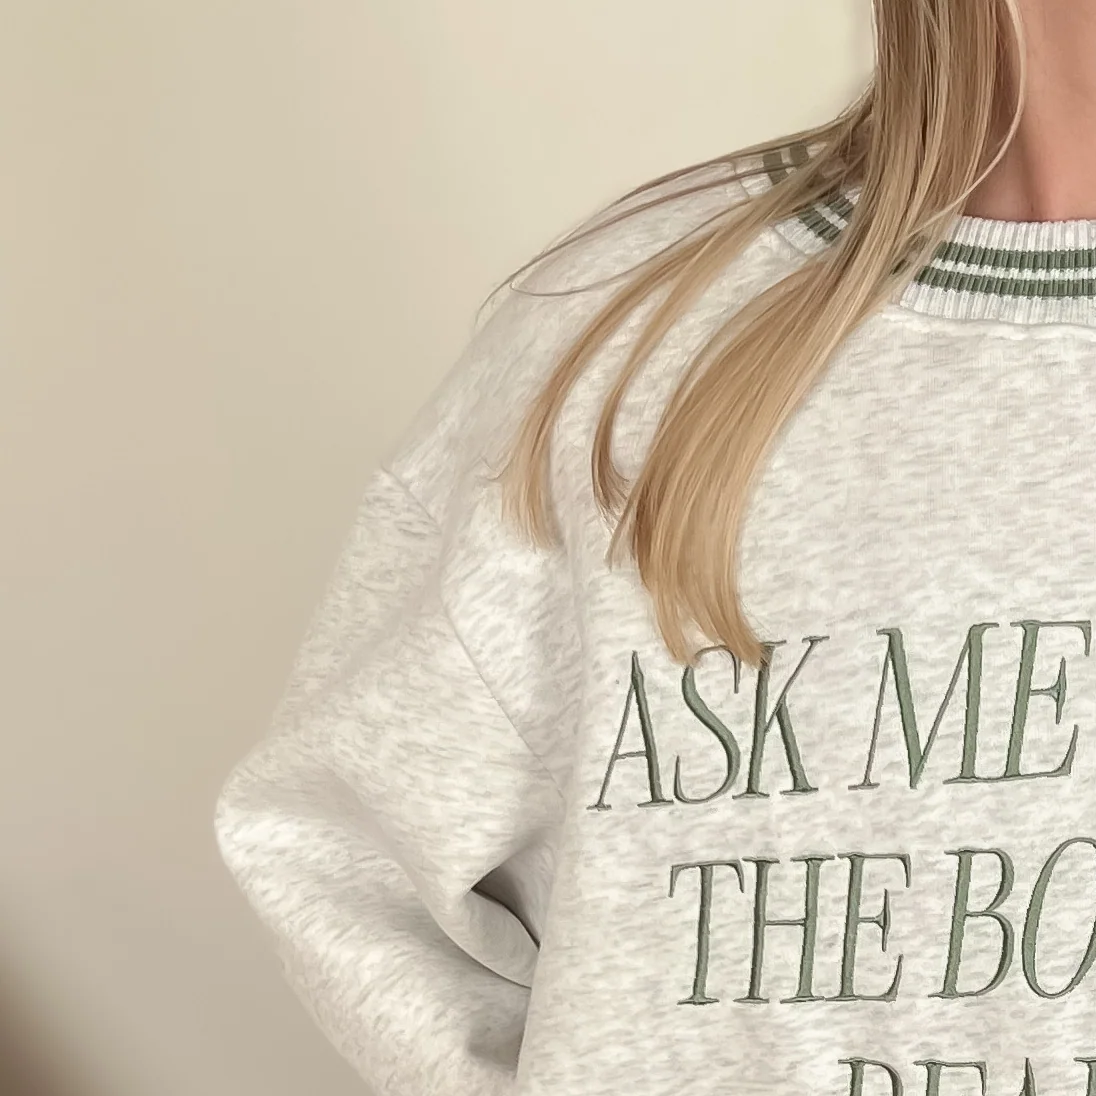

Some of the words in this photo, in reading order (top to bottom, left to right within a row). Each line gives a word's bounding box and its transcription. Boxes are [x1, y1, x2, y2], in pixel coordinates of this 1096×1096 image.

[586, 634, 830, 811] ASK
[847, 619, 1092, 790] ME
[668, 851, 912, 1006] THE
